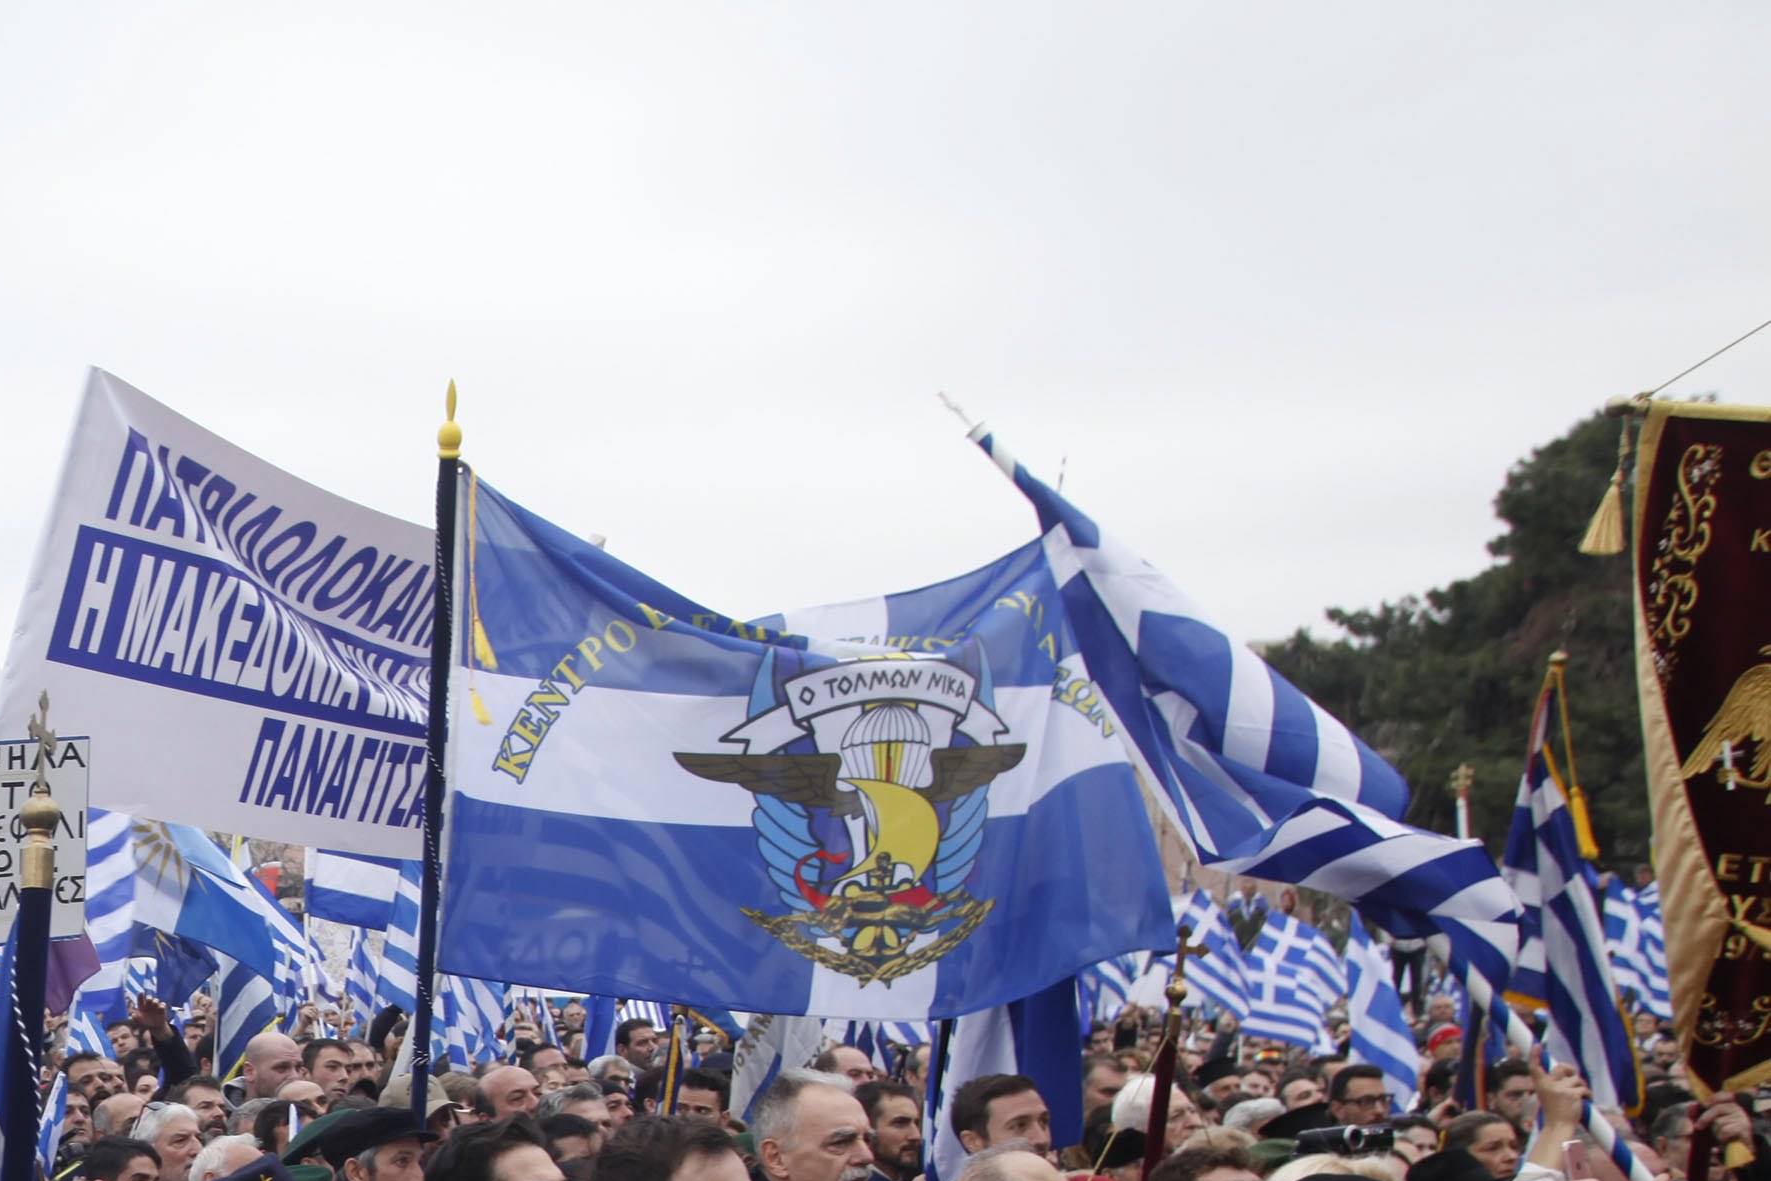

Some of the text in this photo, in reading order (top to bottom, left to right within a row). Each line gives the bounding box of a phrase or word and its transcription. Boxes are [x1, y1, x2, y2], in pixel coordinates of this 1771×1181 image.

[68, 541, 124, 654] Η
[116, 553, 358, 710] ΜΑΚΕΔΟΝΙΑ
[799, 669, 966, 706] Ο ΤΟΛΜΩΝ ΝΙΚΑ
